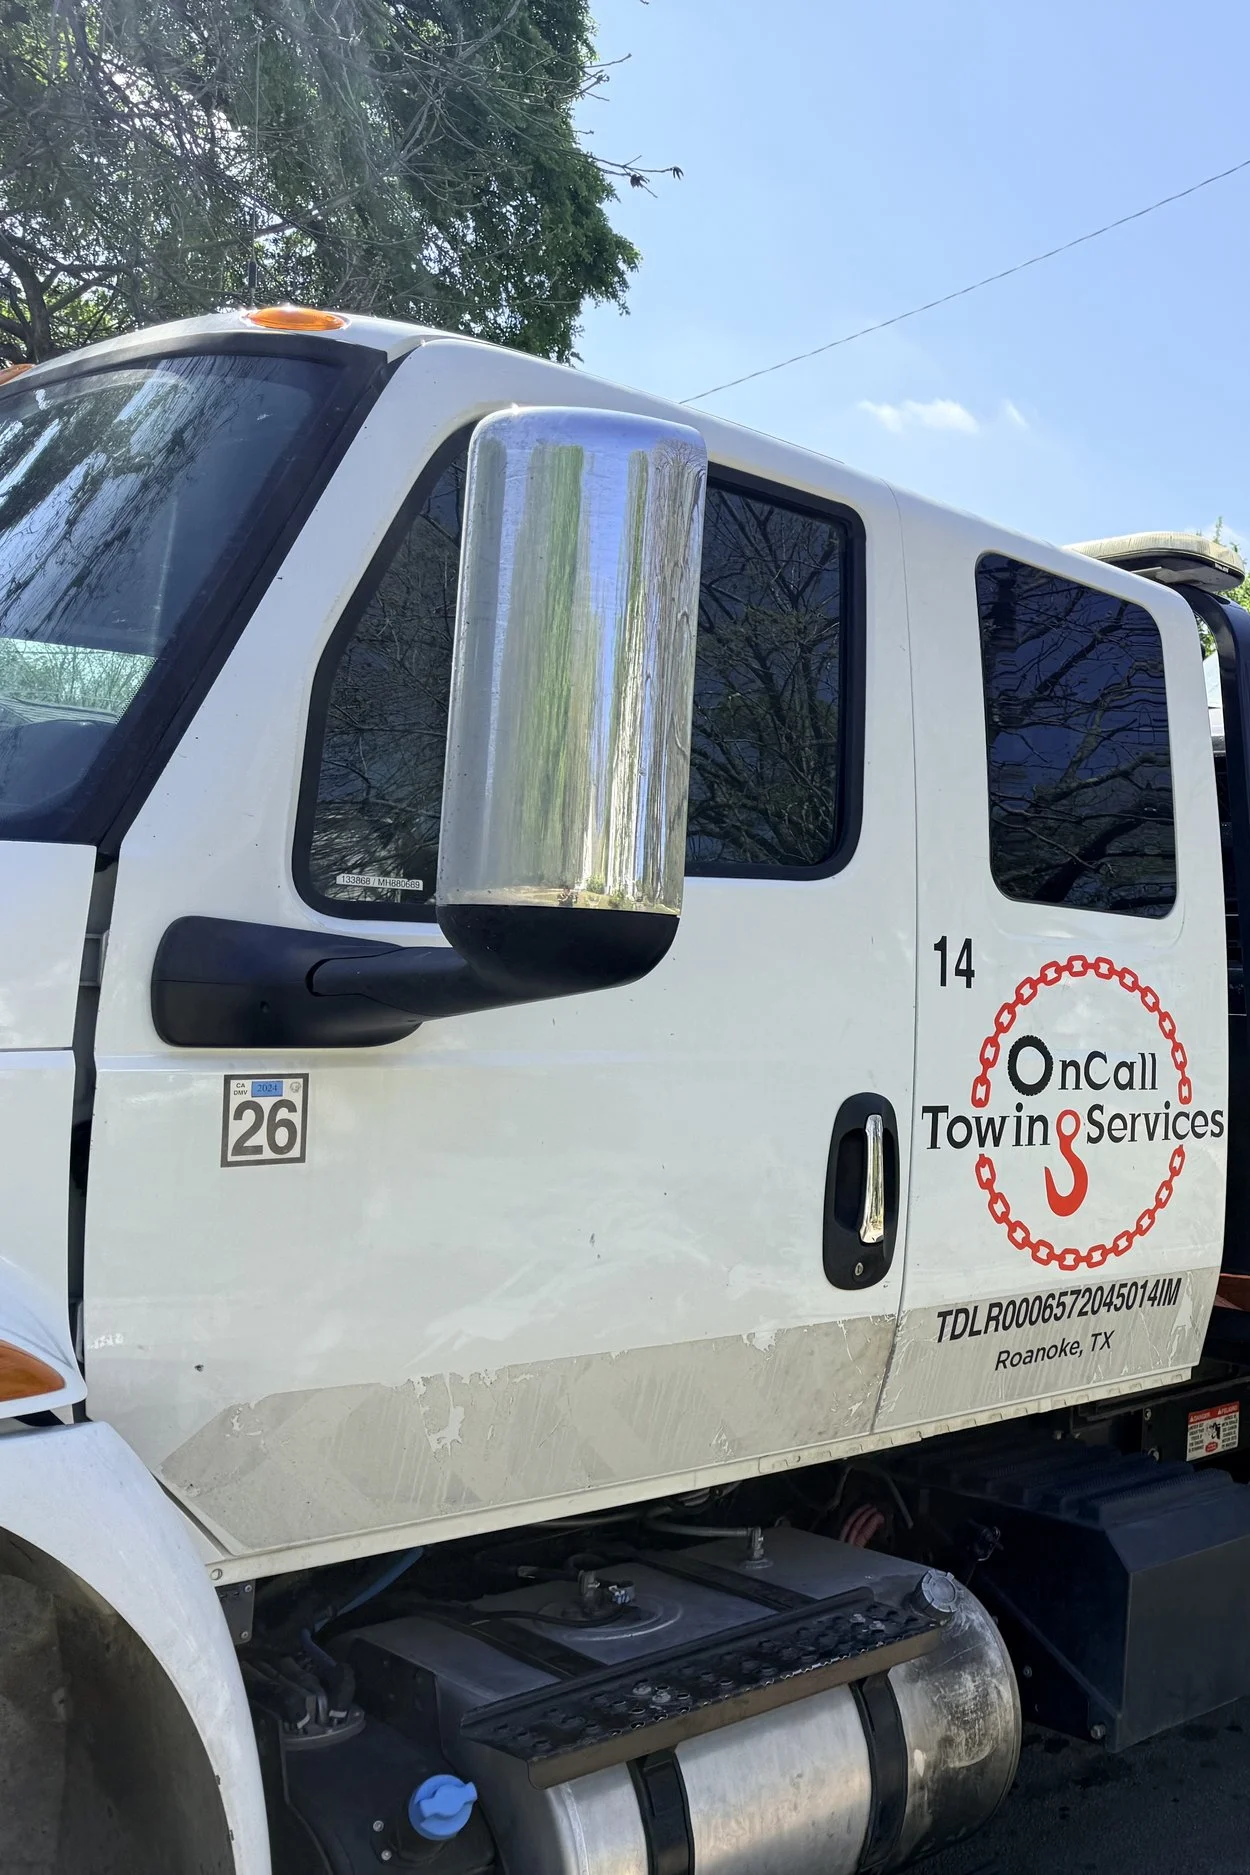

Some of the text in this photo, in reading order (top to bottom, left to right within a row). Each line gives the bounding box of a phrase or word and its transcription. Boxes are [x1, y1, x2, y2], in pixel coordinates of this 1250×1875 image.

[341, 875, 371, 885] 133868
[933, 936, 975, 989] 14
[1008, 1035, 1158, 1096] OnCall
[257, 1084, 278, 1093] 2024
[231, 1099, 297, 1156] 26
[1086, 1101, 1225, 1145] Services
[995, 1330, 1115, 1371] Roanoke, TX
